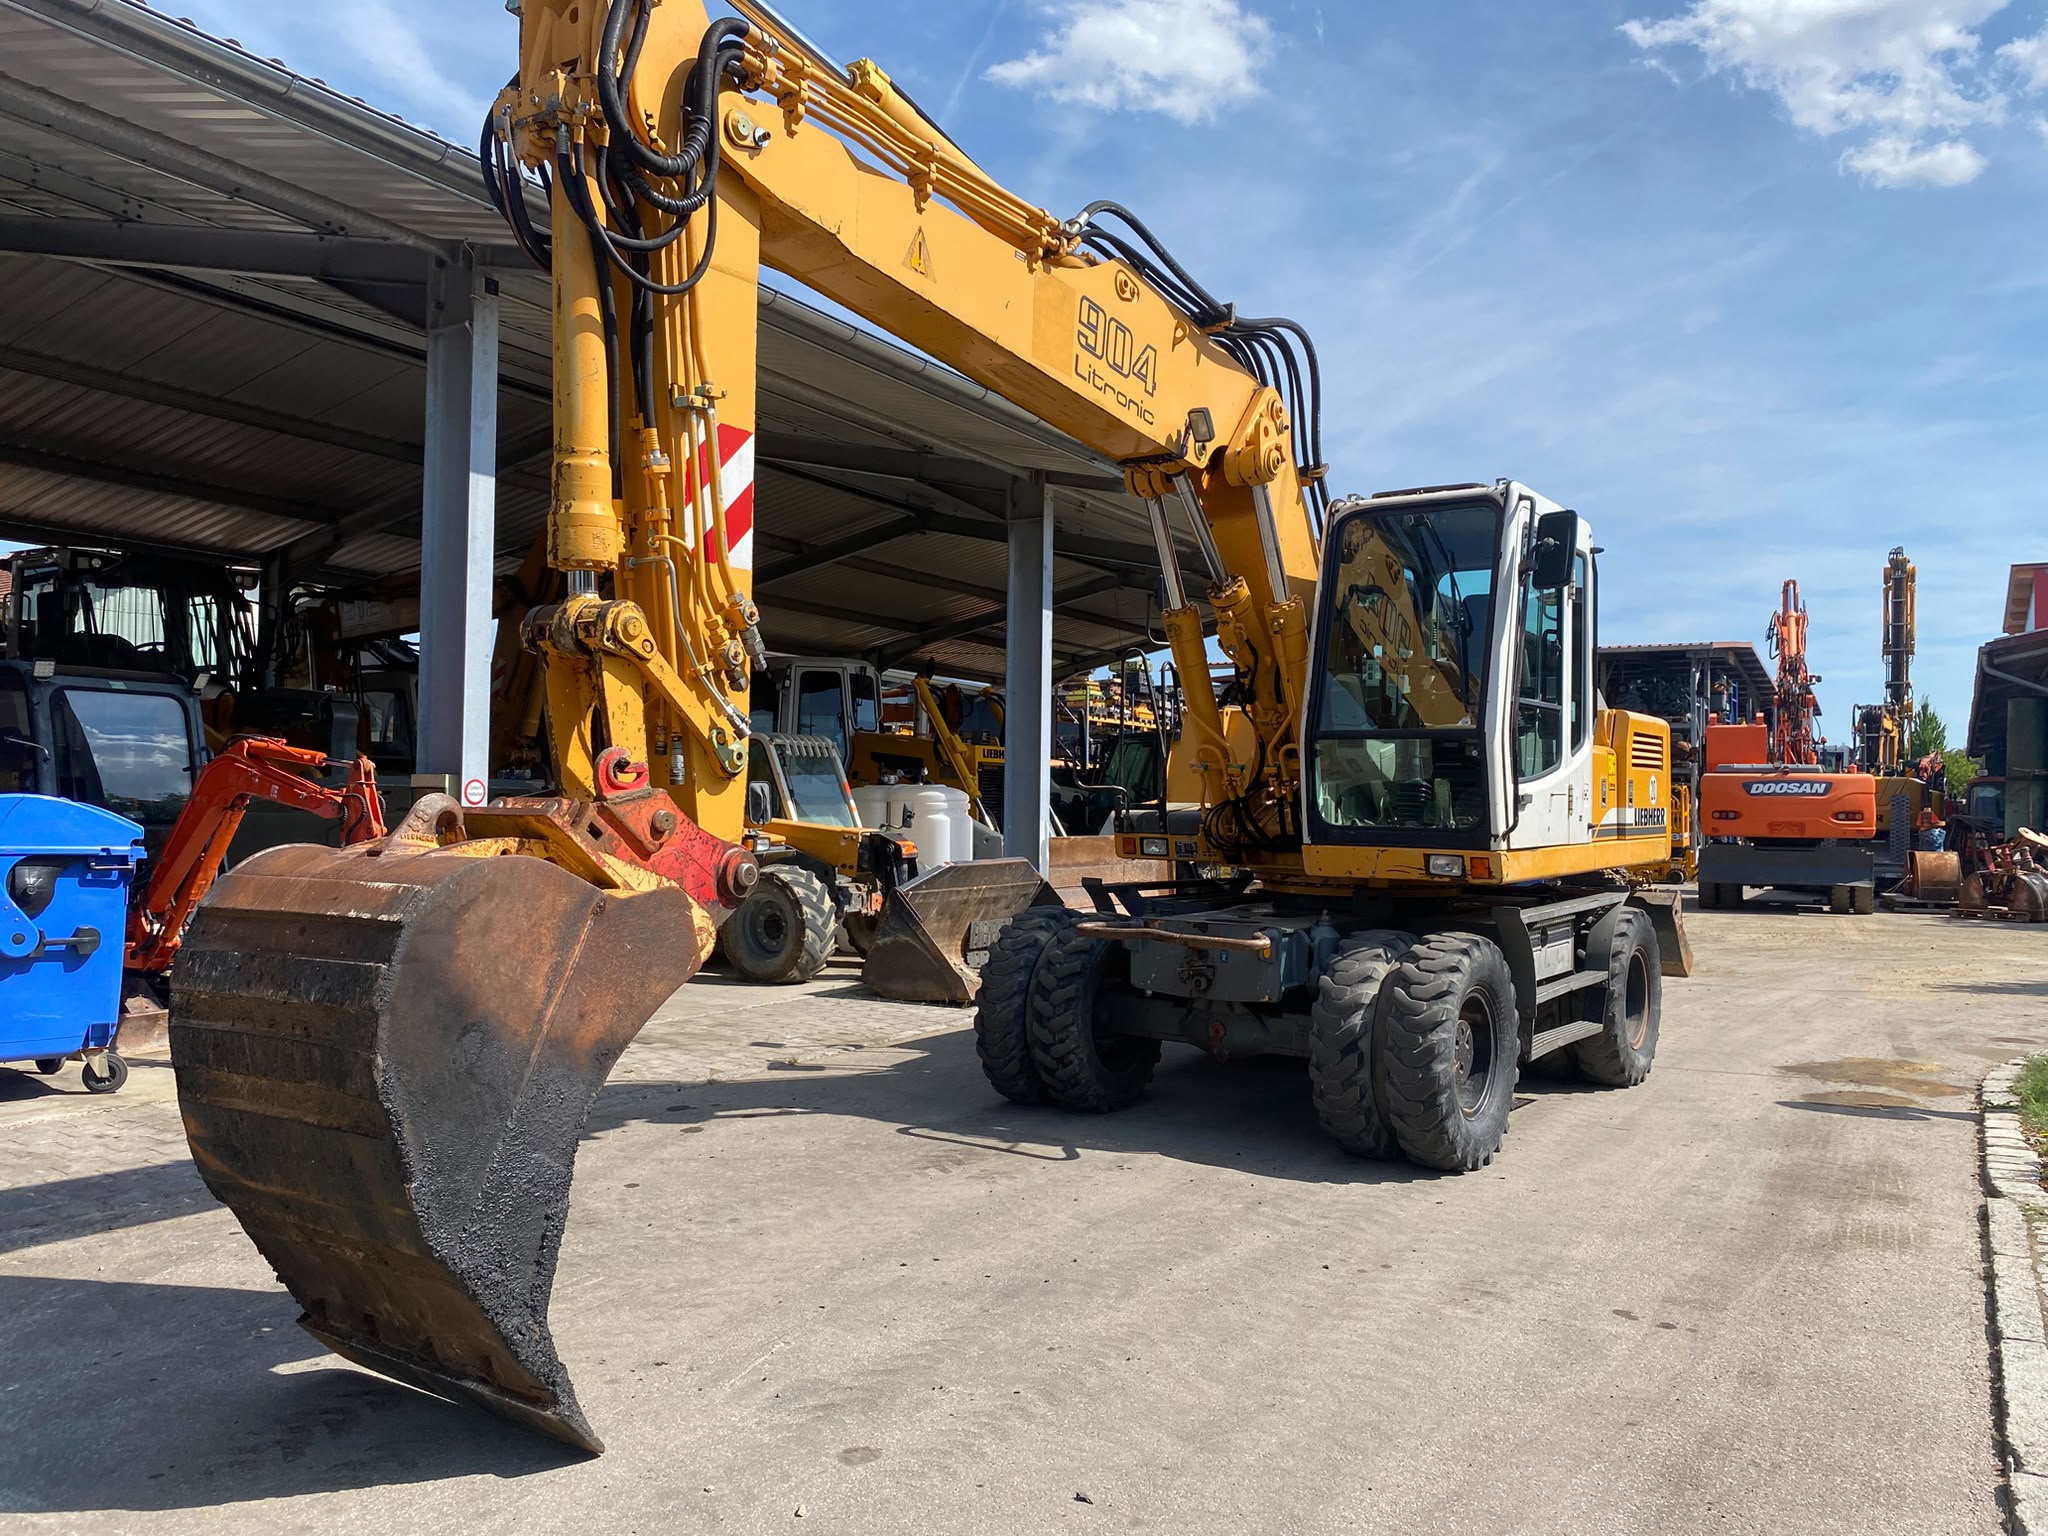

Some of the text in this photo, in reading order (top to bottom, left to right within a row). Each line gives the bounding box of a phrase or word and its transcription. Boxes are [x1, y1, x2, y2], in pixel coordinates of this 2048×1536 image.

[1077, 295, 1157, 398] 904
[1074, 353, 1154, 426] Litronic
[983, 749, 1004, 759] LIEBH
[1750, 783, 1826, 794] DOOSAN
[1634, 808, 1665, 826] LIEBHERR
